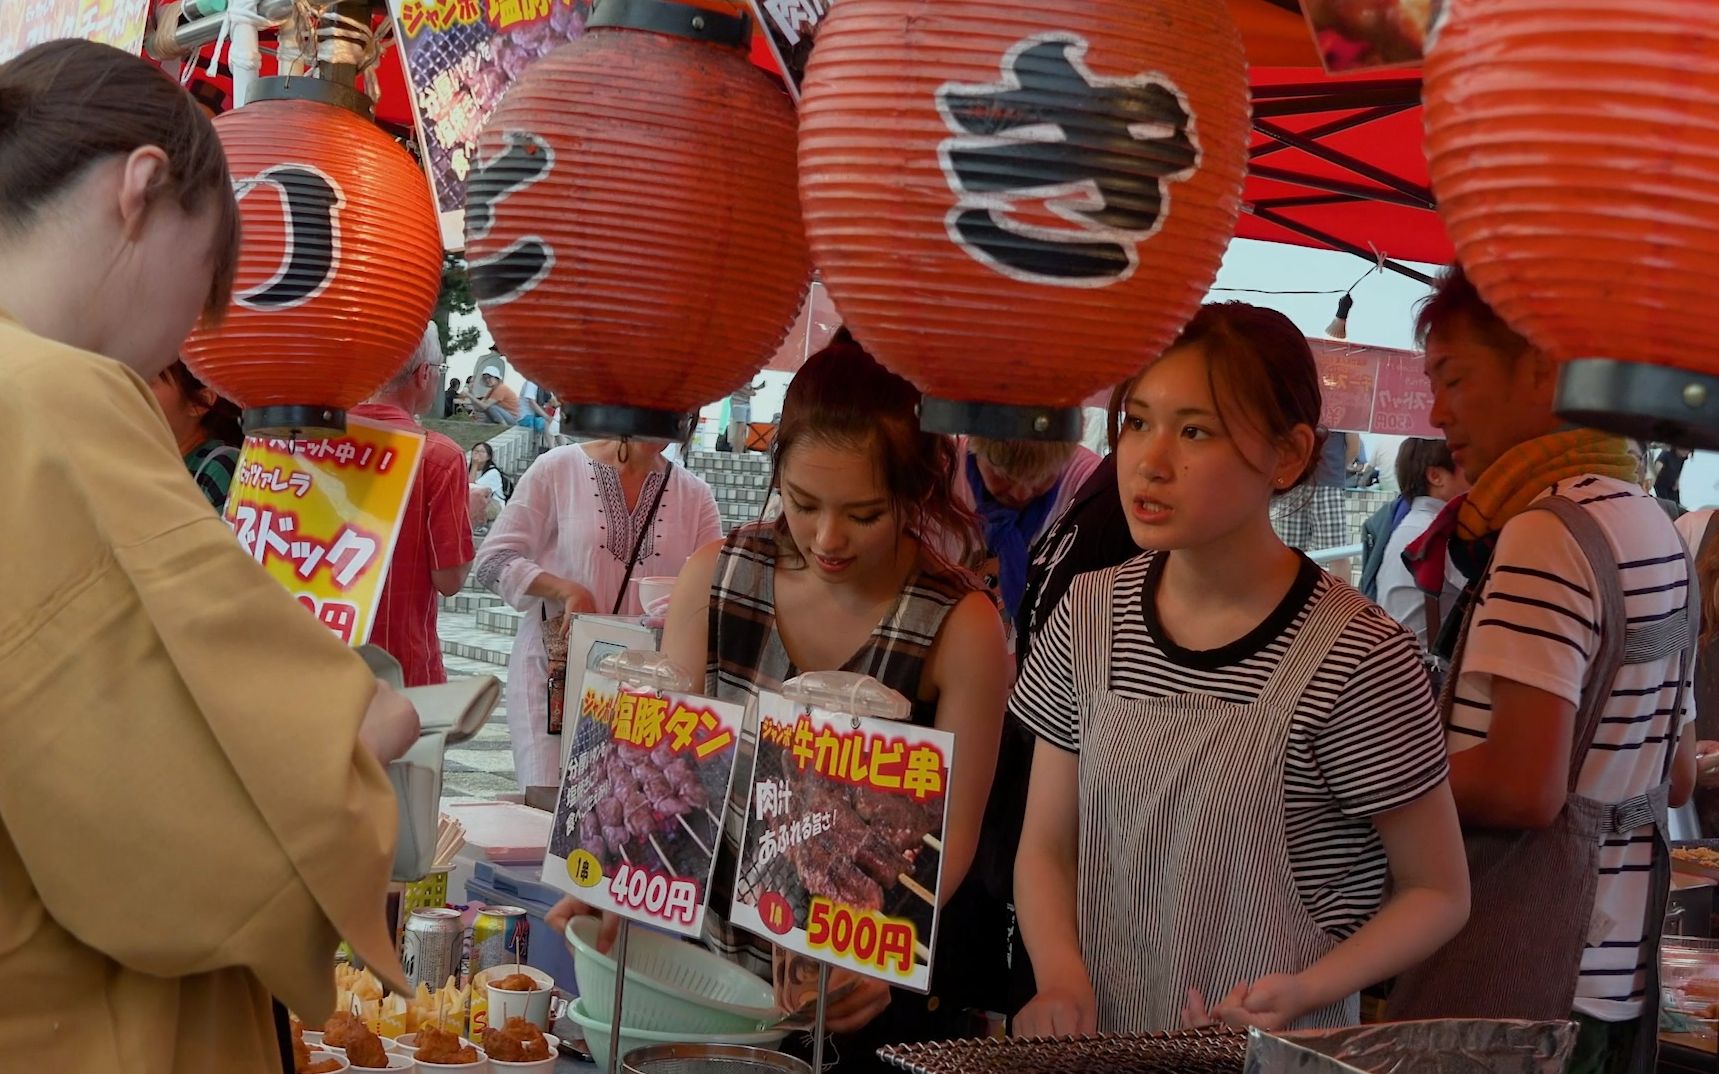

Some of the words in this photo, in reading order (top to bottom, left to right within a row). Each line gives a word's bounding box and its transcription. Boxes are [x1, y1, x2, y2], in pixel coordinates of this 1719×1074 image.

[613, 692, 732, 758] 塩豚タン
[792, 721, 942, 798] 牛カルビ串
[756, 779, 792, 821] 肉汁
[610, 864, 697, 923] 400円
[808, 901, 914, 972] 500円
